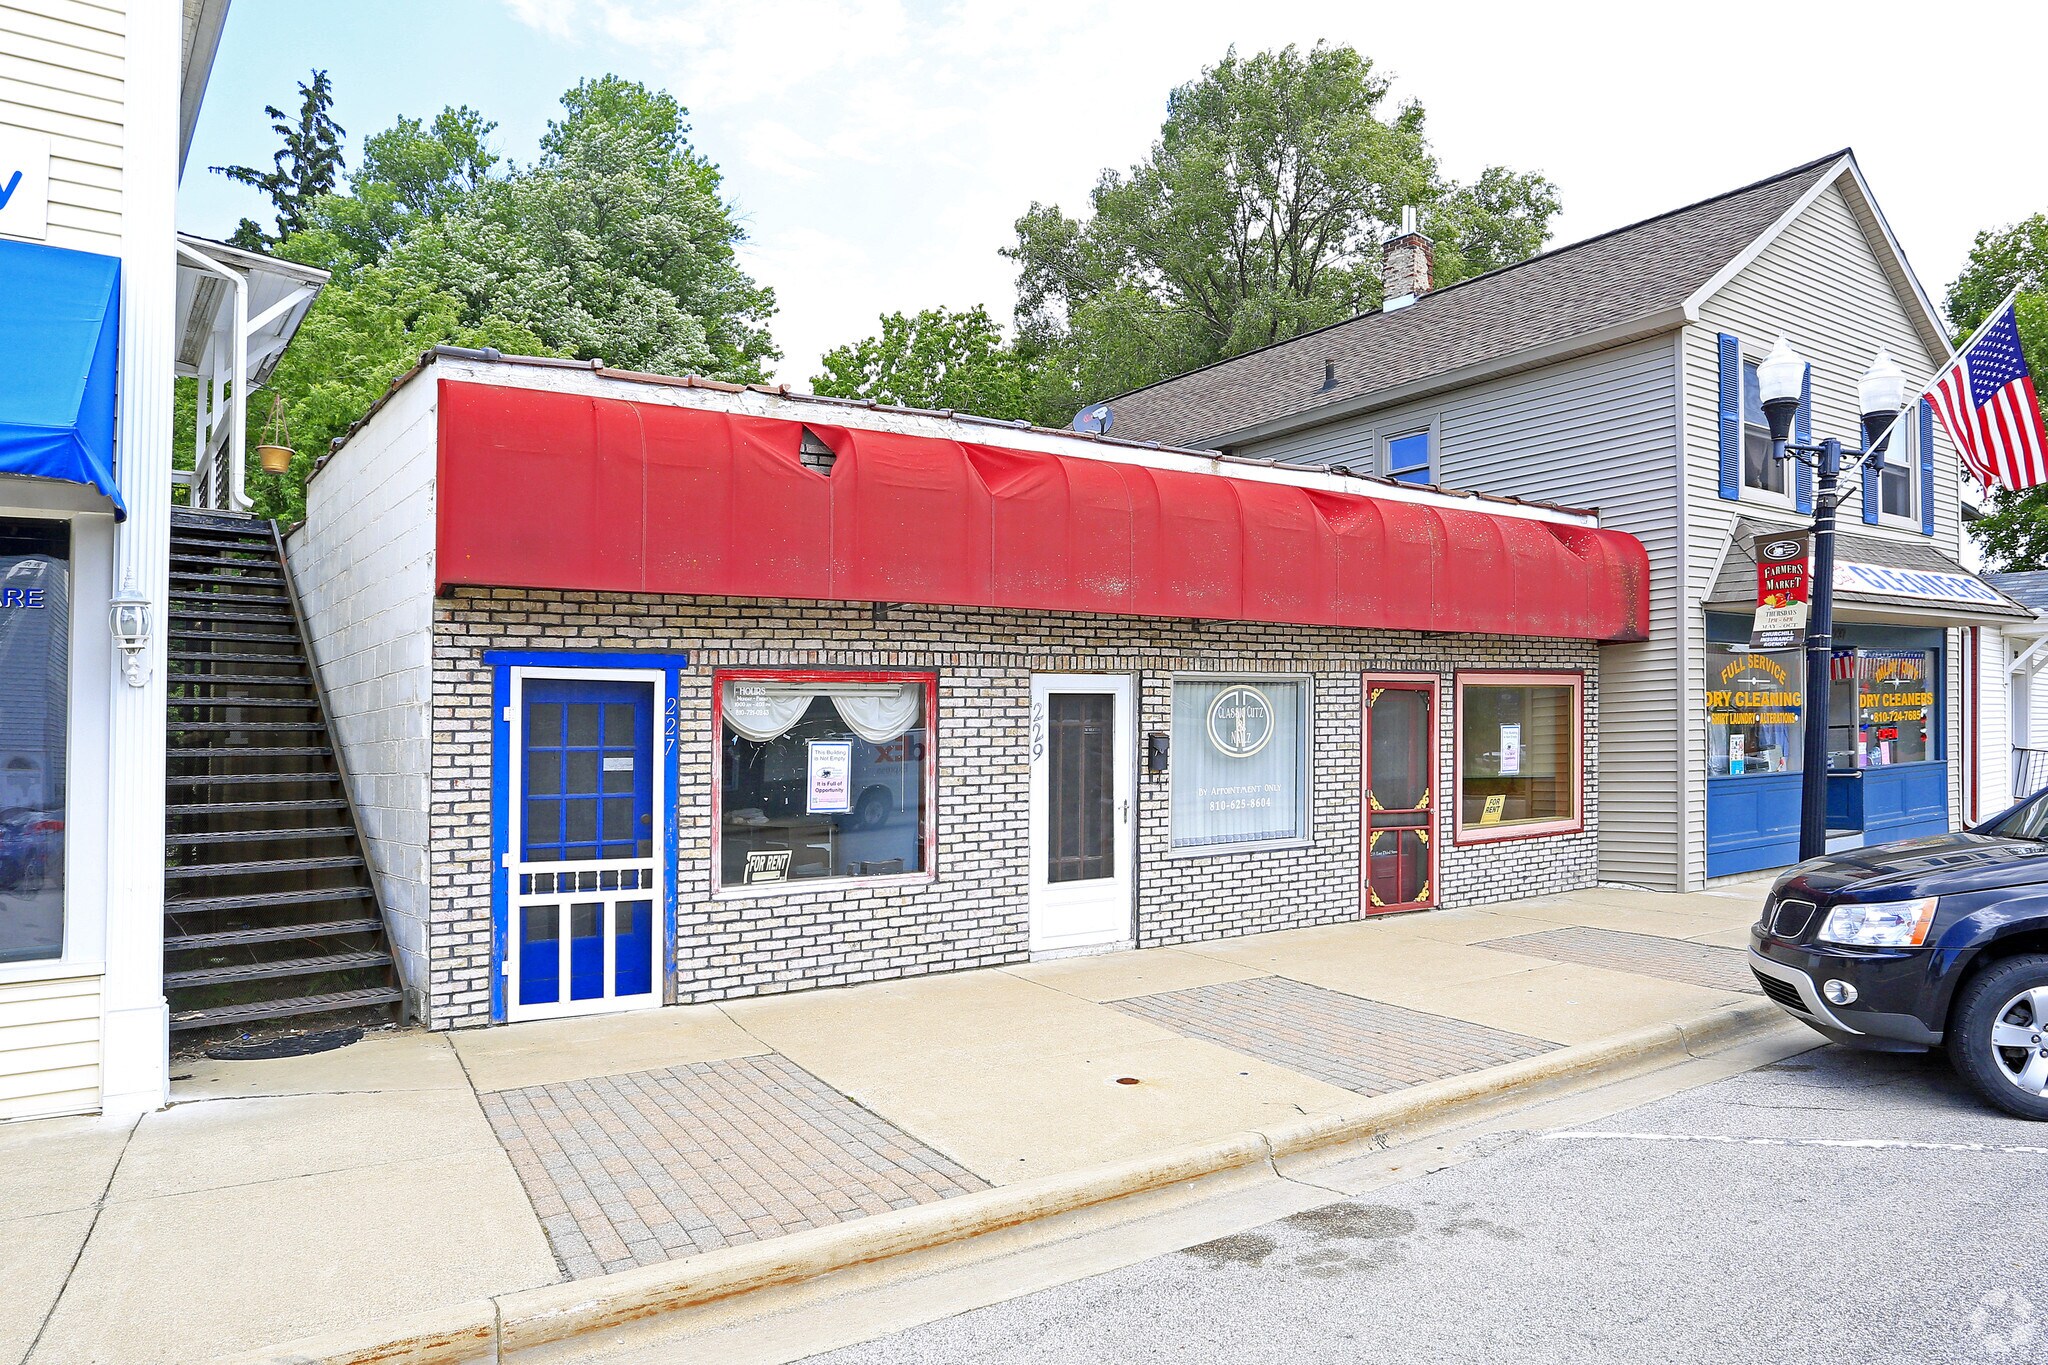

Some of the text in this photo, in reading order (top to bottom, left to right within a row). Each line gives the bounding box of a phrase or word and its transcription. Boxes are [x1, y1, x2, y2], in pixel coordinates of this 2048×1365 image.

[1764, 564, 1803, 579] FARMERS
[1766, 577, 1802, 590] MARKET
[1848, 565, 1998, 601] CLEANERS
[0, 587, 45, 608] RE
[1720, 654, 1787, 685] FULL SERVICE
[739, 687, 766, 696] HOURS
[1706, 691, 1802, 707] DRY CLEANING
[1859, 692, 1934, 708] DRY CLEANERS
[1246, 705, 1264, 718] CUTZ
[1711, 713, 1795, 724] SHIRT LAUNDRY ALTERATIONS
[1873, 710, 1921, 722] 810-724-7685
[665, 697, 677, 756] 227
[1032, 702, 1044, 761] 229
[1878, 728, 1897, 740] OPEN
[1198, 784, 1281, 796] BY APPOINTMENT ONLY
[1209, 797, 1271, 811] 810-625-8604
[1485, 806, 1500, 814] RENT
[749, 854, 788, 872] FOR RENT
